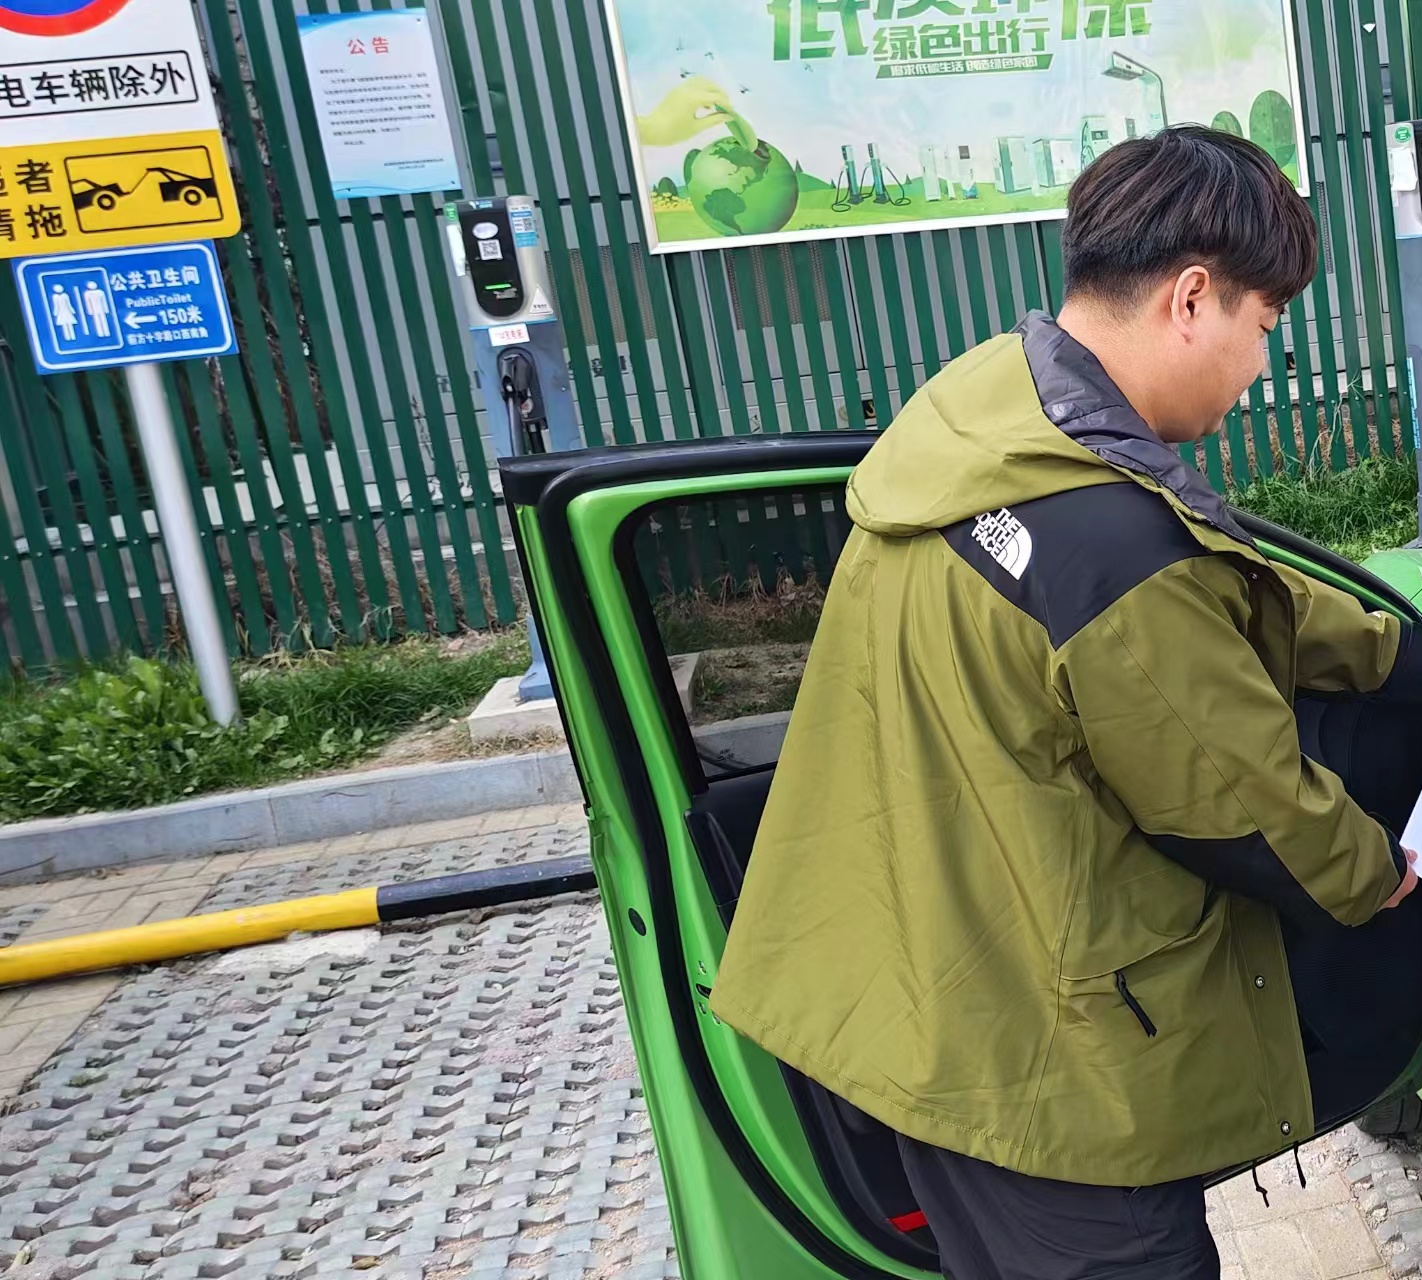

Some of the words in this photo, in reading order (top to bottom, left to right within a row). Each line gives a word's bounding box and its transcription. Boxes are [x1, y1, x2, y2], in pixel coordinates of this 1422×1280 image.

[347, 36, 389, 55] 公告
[872, 18, 1050, 61] 绿色出行
[890, 60, 965, 77] 追求低碳生活
[0, 61, 187, 108] 电车辆除外
[0, 159, 53, 198] 者
[110, 265, 200, 291] 公共卫生间
[159, 304, 204, 325] 150米
[974, 512, 1013, 547] ORTH
[995, 507, 1023, 535] THE
[970, 523, 1005, 560] FACE
